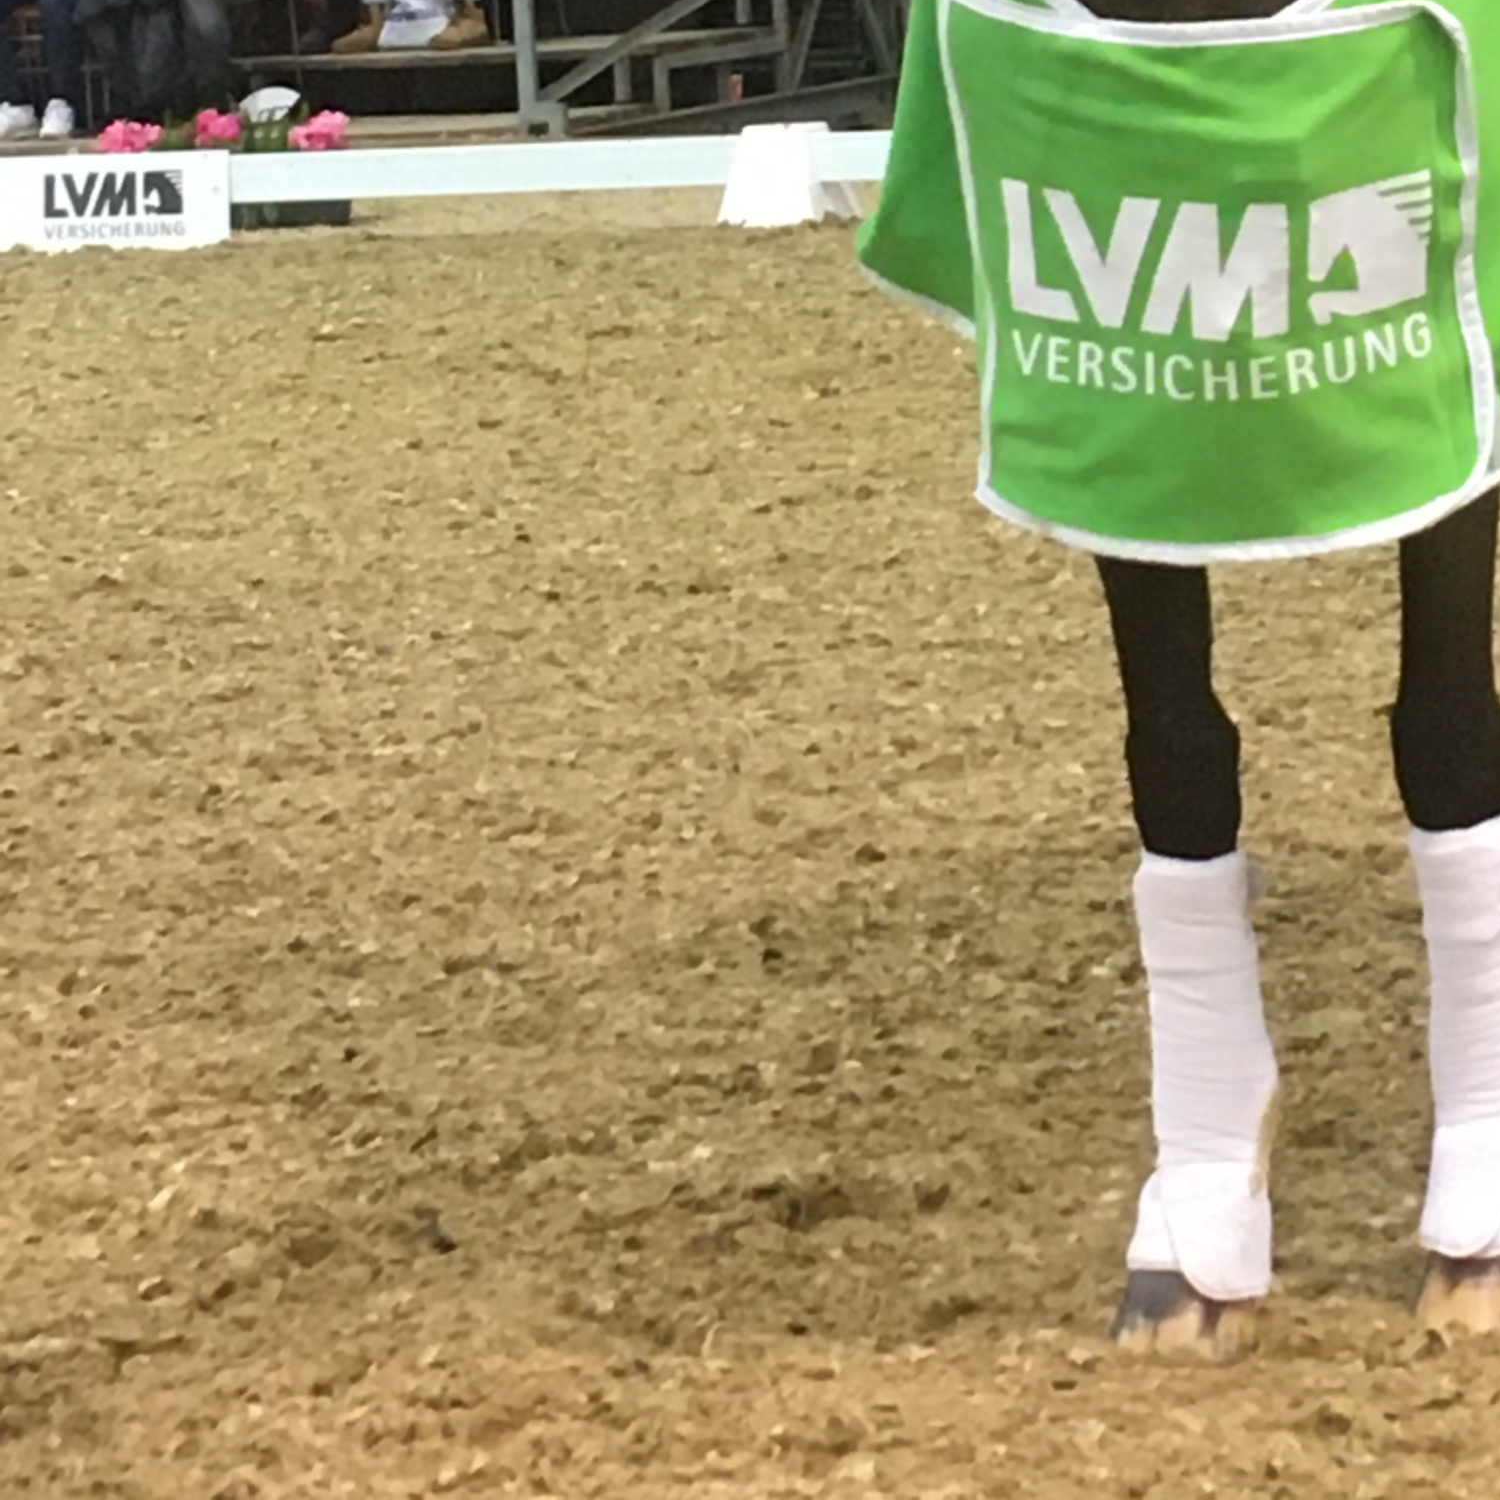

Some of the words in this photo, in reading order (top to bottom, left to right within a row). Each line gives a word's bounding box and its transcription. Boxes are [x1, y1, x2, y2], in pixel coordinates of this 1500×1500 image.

[44, 172, 136, 218] LVM
[45, 221, 186, 239] VERSICHERUNG
[1000, 177, 1290, 343] LVM
[1011, 312, 1433, 401] VERSICHERUNG
